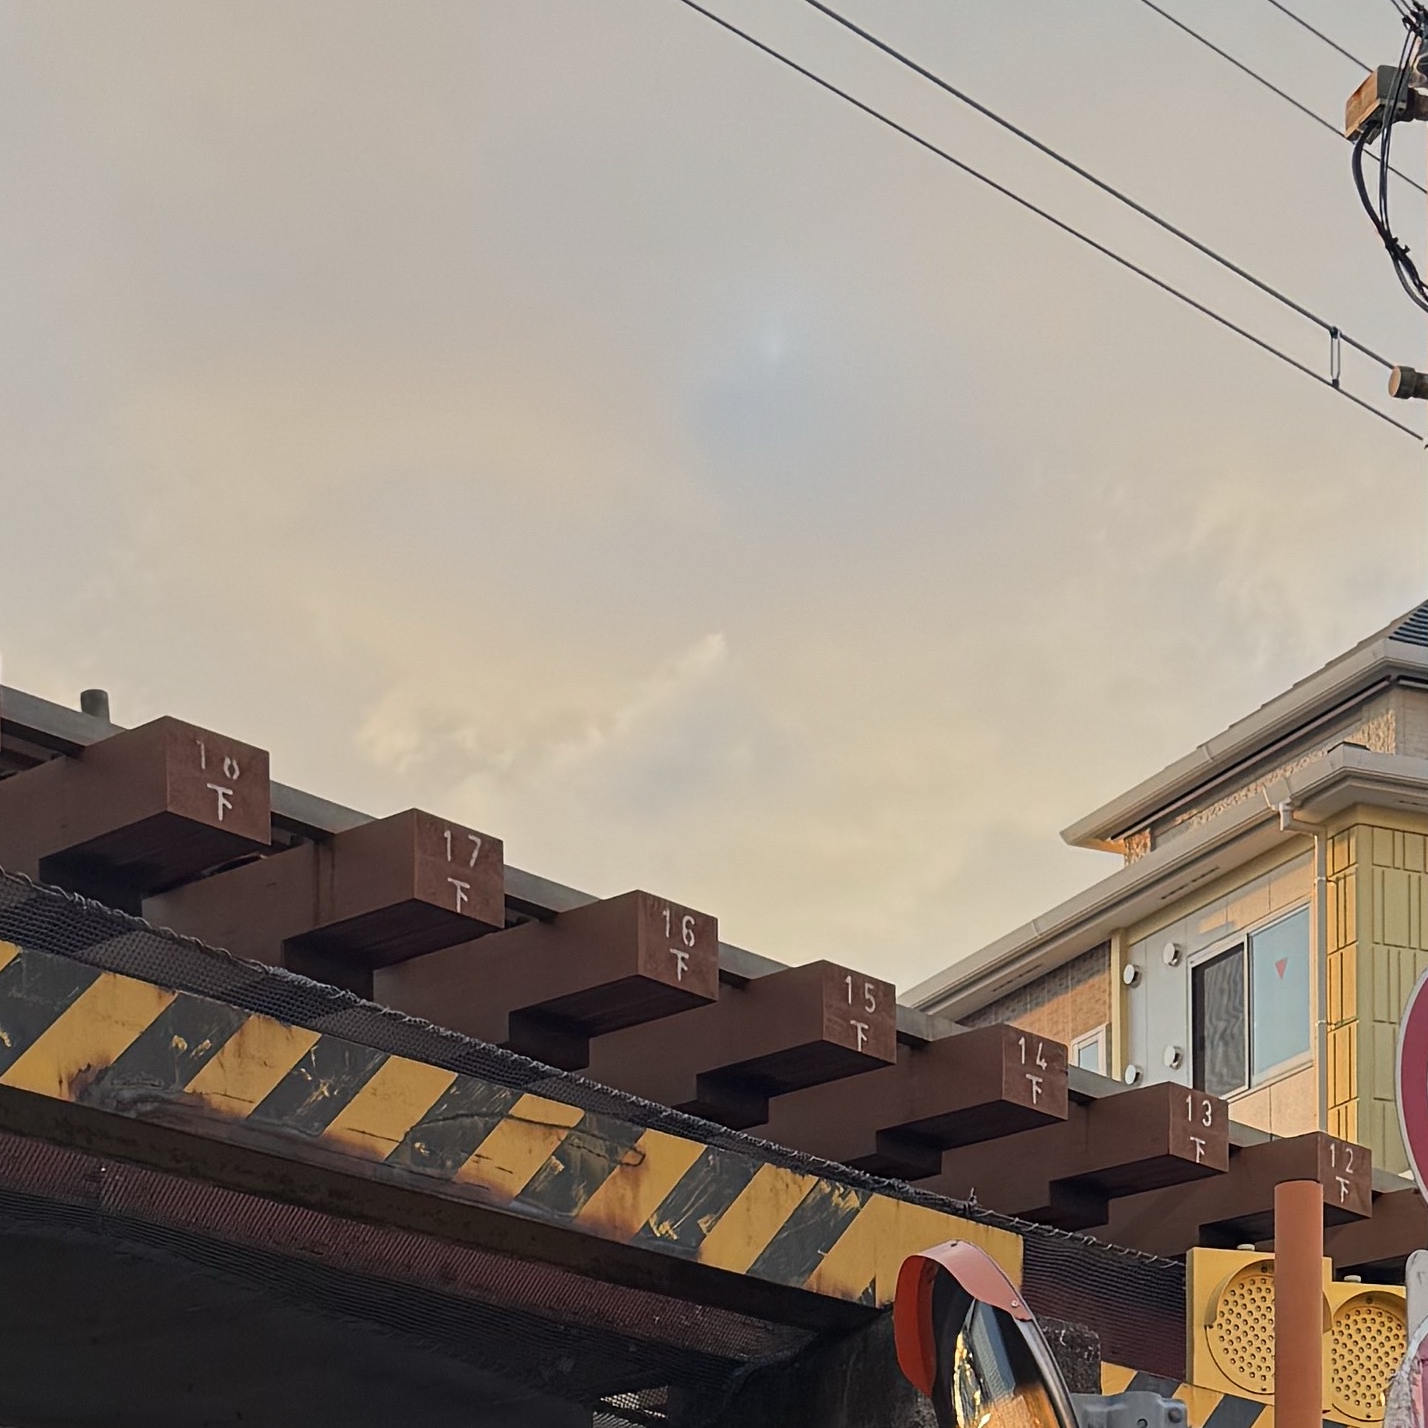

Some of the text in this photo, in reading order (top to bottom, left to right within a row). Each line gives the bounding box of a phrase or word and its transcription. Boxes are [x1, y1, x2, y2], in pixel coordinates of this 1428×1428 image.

[206, 782, 234, 822] 下
[443, 829, 482, 868] 17
[447, 877, 471, 914] 下
[662, 905, 696, 948] 16
[669, 948, 690, 982] 下
[844, 974, 876, 1013] 15
[849, 1019, 869, 1053] 下
[1016, 1035, 1048, 1071] 14
[1025, 1072, 1044, 1105] 下
[1184, 1093, 1213, 1128] 13
[1189, 1135, 1206, 1164] 下
[1328, 1142, 1355, 1175] 12
[1335, 1175, 1351, 1204] 下
